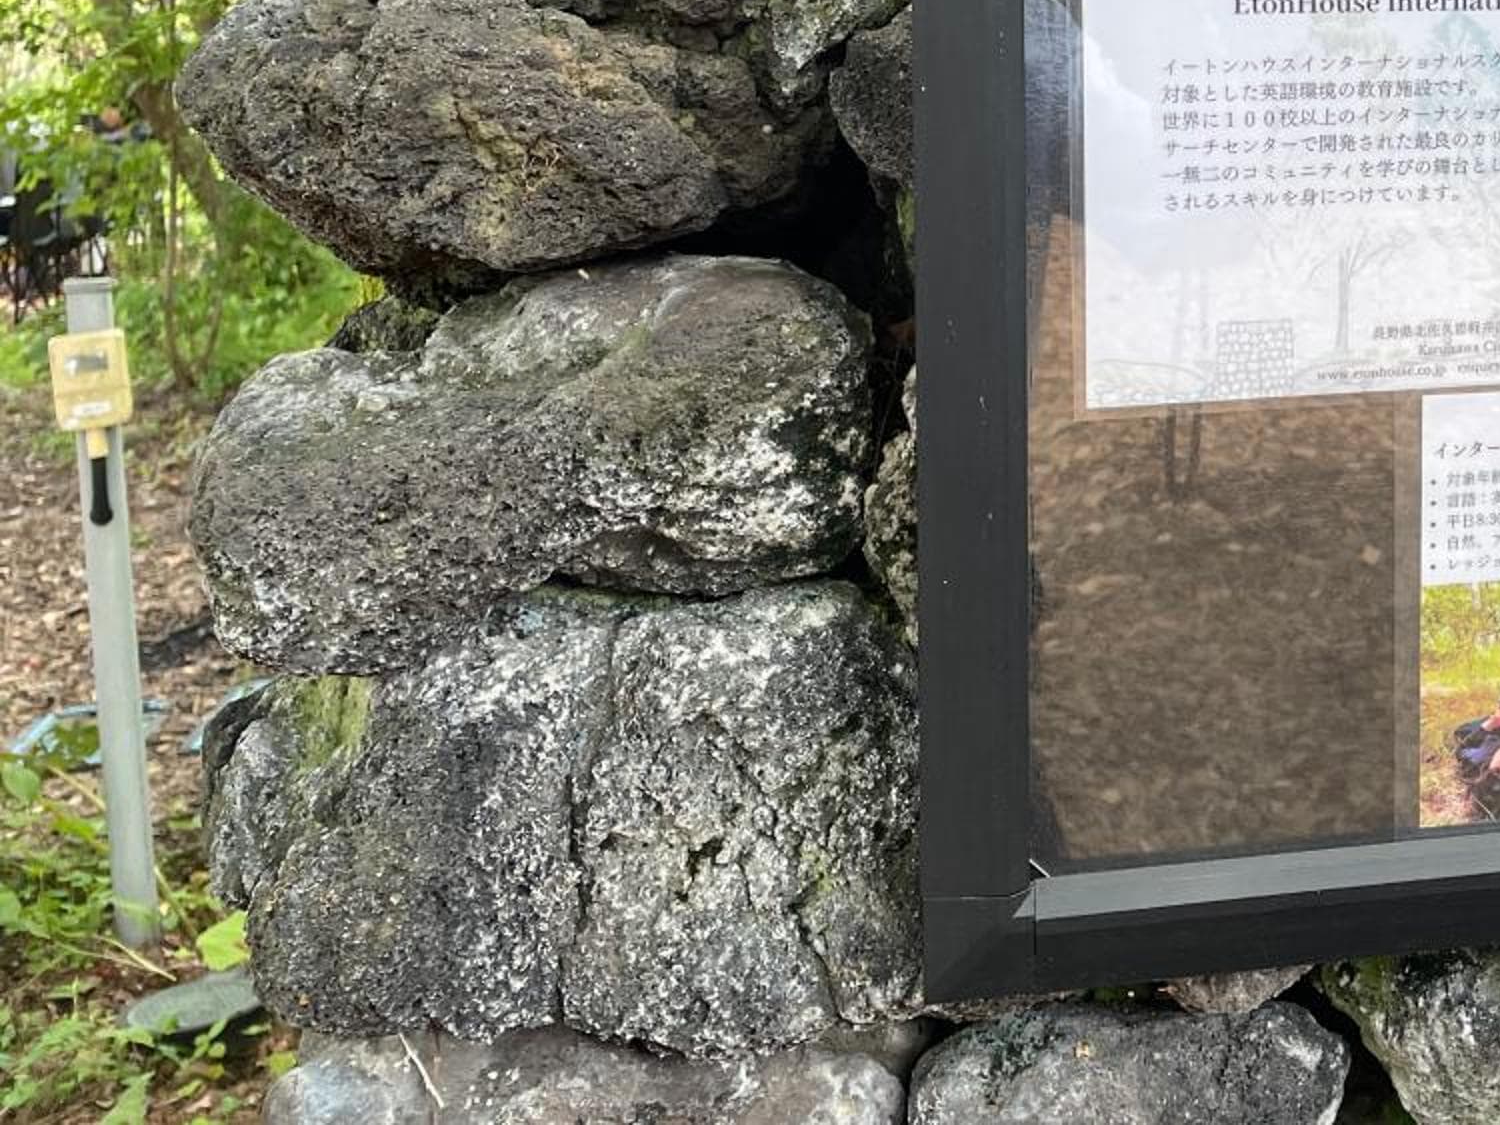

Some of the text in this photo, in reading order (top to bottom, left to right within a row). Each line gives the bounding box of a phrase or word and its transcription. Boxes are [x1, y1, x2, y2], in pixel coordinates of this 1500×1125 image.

[1163, 78, 1477, 104] 対象とした英語環境の教育施設です。
[1165, 184, 1460, 211] されるスキルを身につけています。
